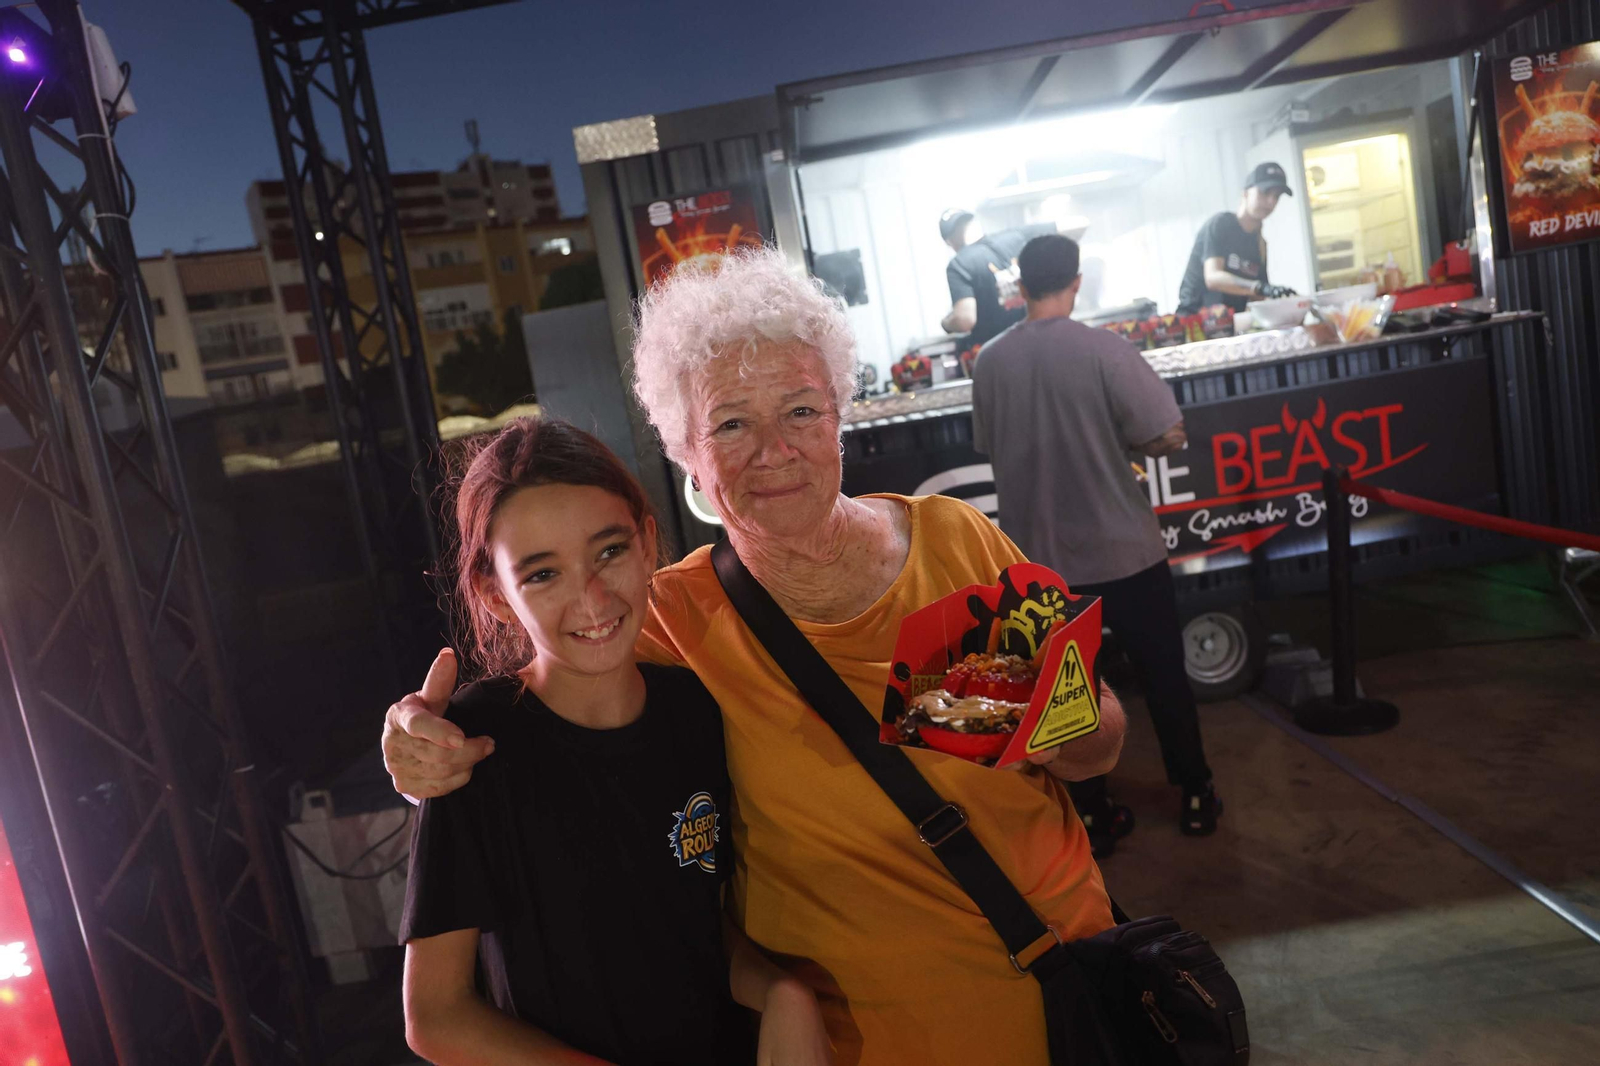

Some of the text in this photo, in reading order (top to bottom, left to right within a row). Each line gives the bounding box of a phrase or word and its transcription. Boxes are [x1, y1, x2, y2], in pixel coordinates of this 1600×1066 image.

[1529, 210, 1600, 238] RED DEVI
[1211, 403, 1404, 496] BEAST
[1188, 501, 1288, 541] Smash
[1052, 685, 1086, 709] SUPER
